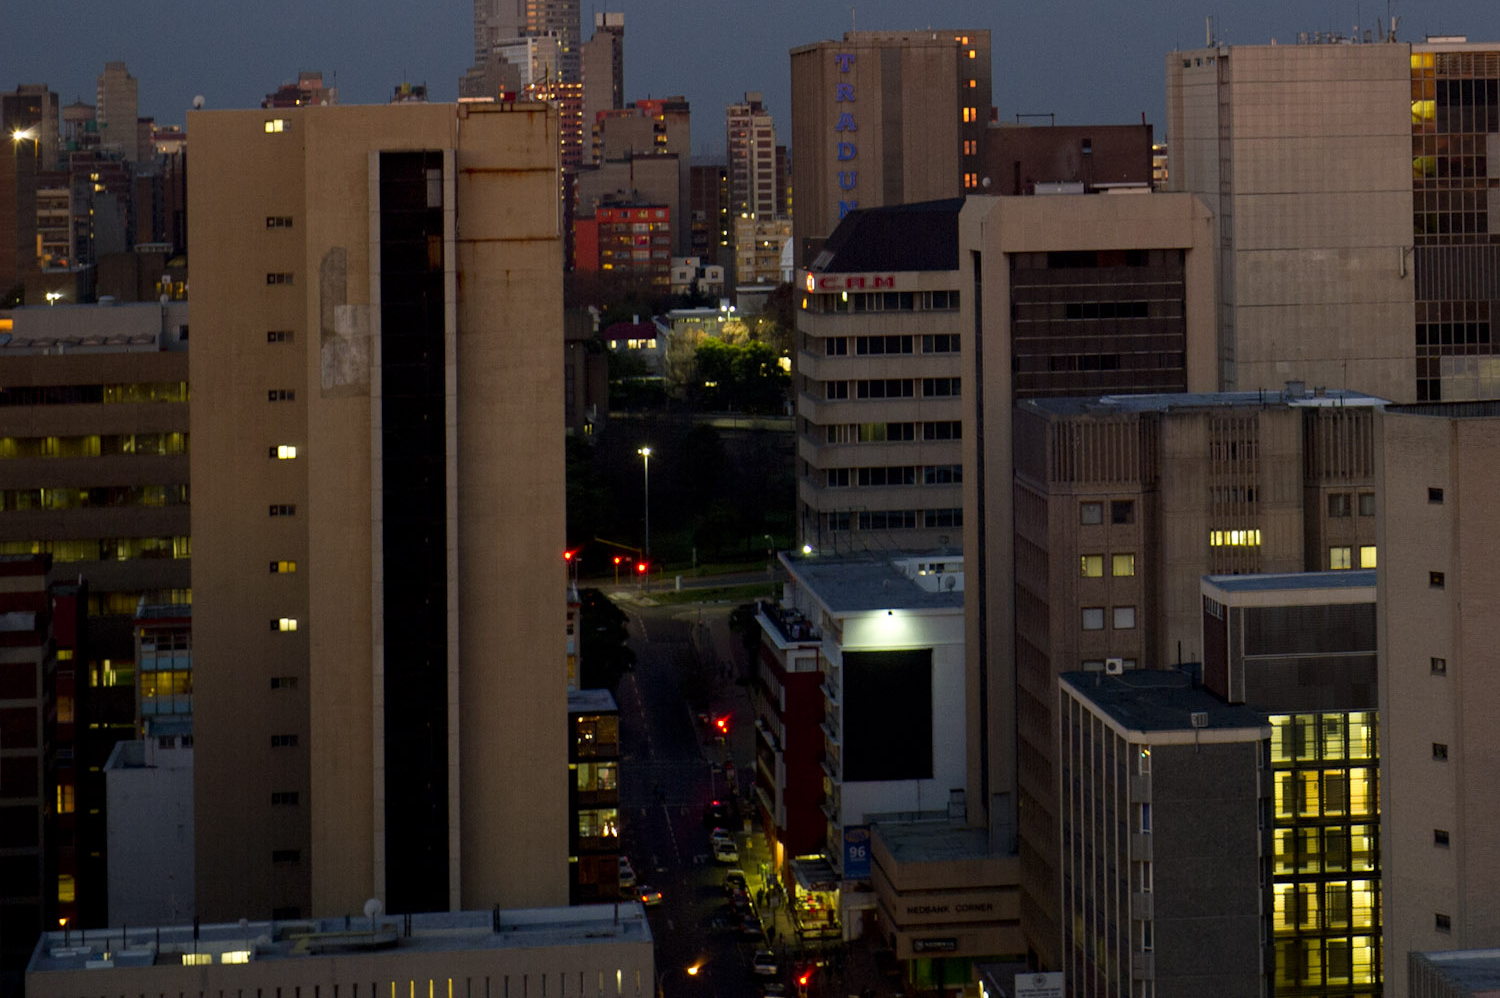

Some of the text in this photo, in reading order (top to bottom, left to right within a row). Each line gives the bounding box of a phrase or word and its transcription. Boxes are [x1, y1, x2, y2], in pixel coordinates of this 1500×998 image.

[849, 845, 866, 858] 96
[907, 903, 993, 914] NEDBANK CORNER
